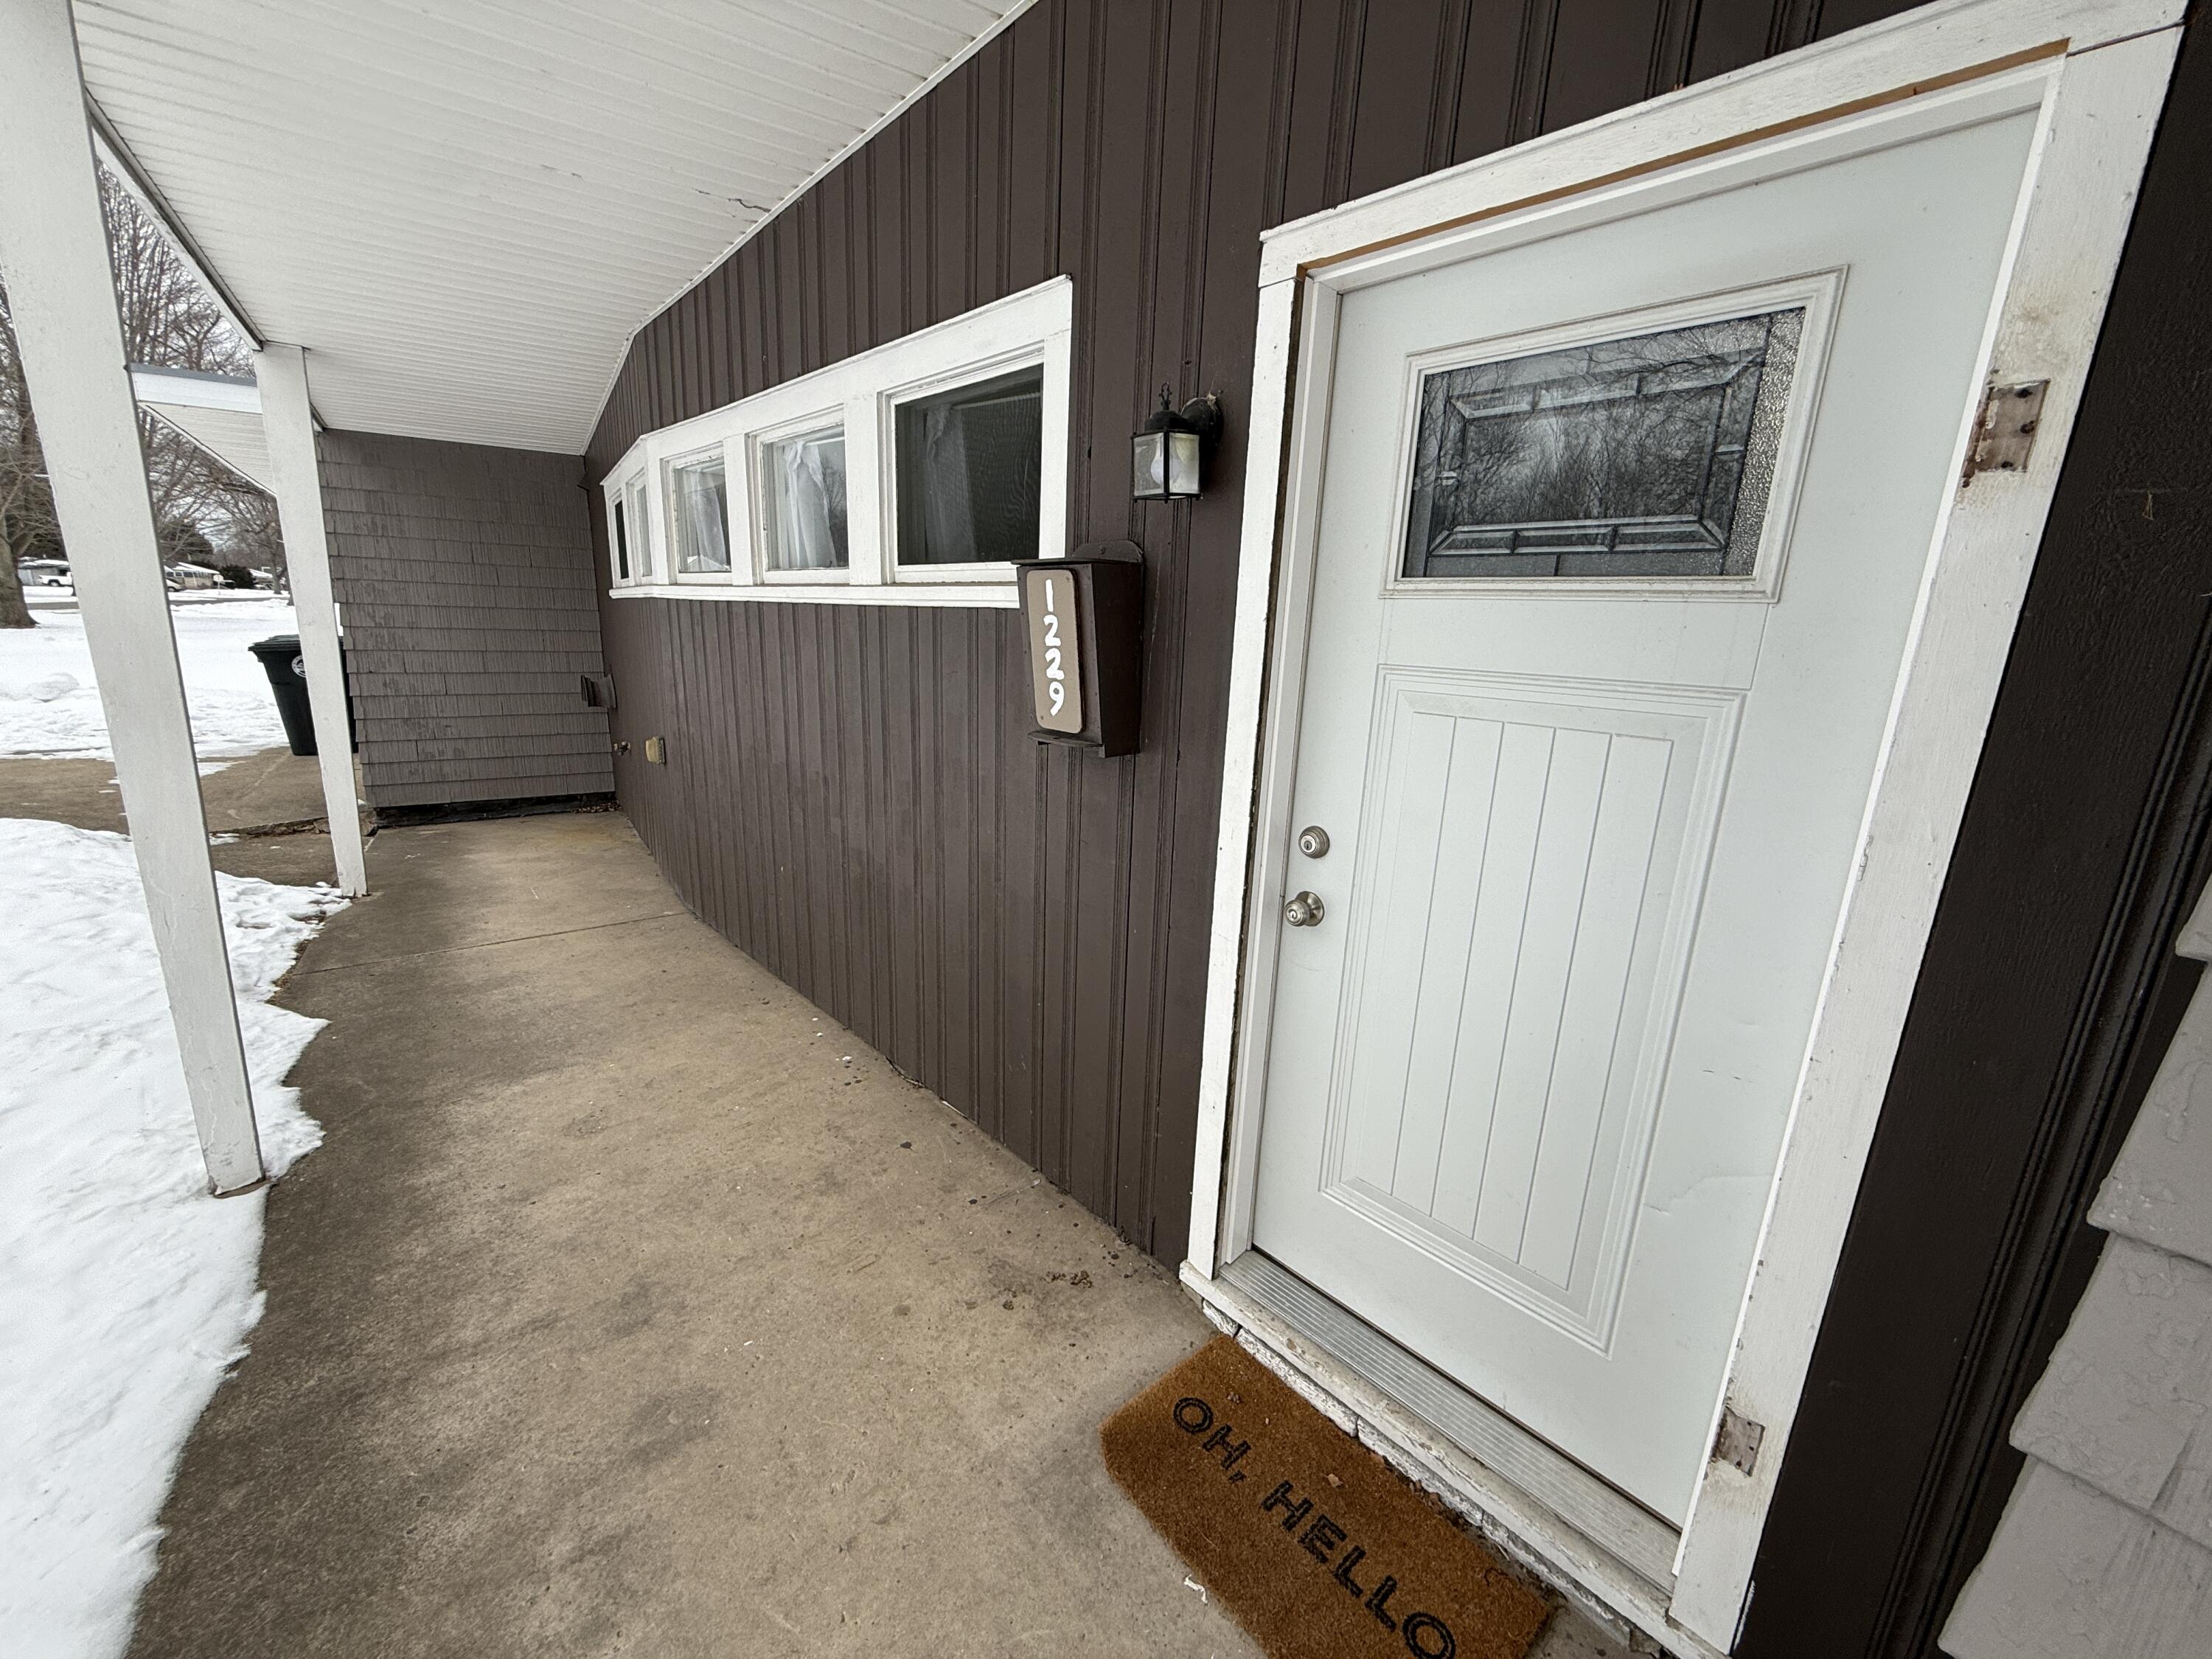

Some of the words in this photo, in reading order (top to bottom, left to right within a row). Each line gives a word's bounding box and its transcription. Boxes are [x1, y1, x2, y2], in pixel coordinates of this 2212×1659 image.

[1043, 579, 1065, 716] 1229
[1173, 1397, 1251, 1482] OH,
[1261, 1481, 1455, 1659] HELLO
